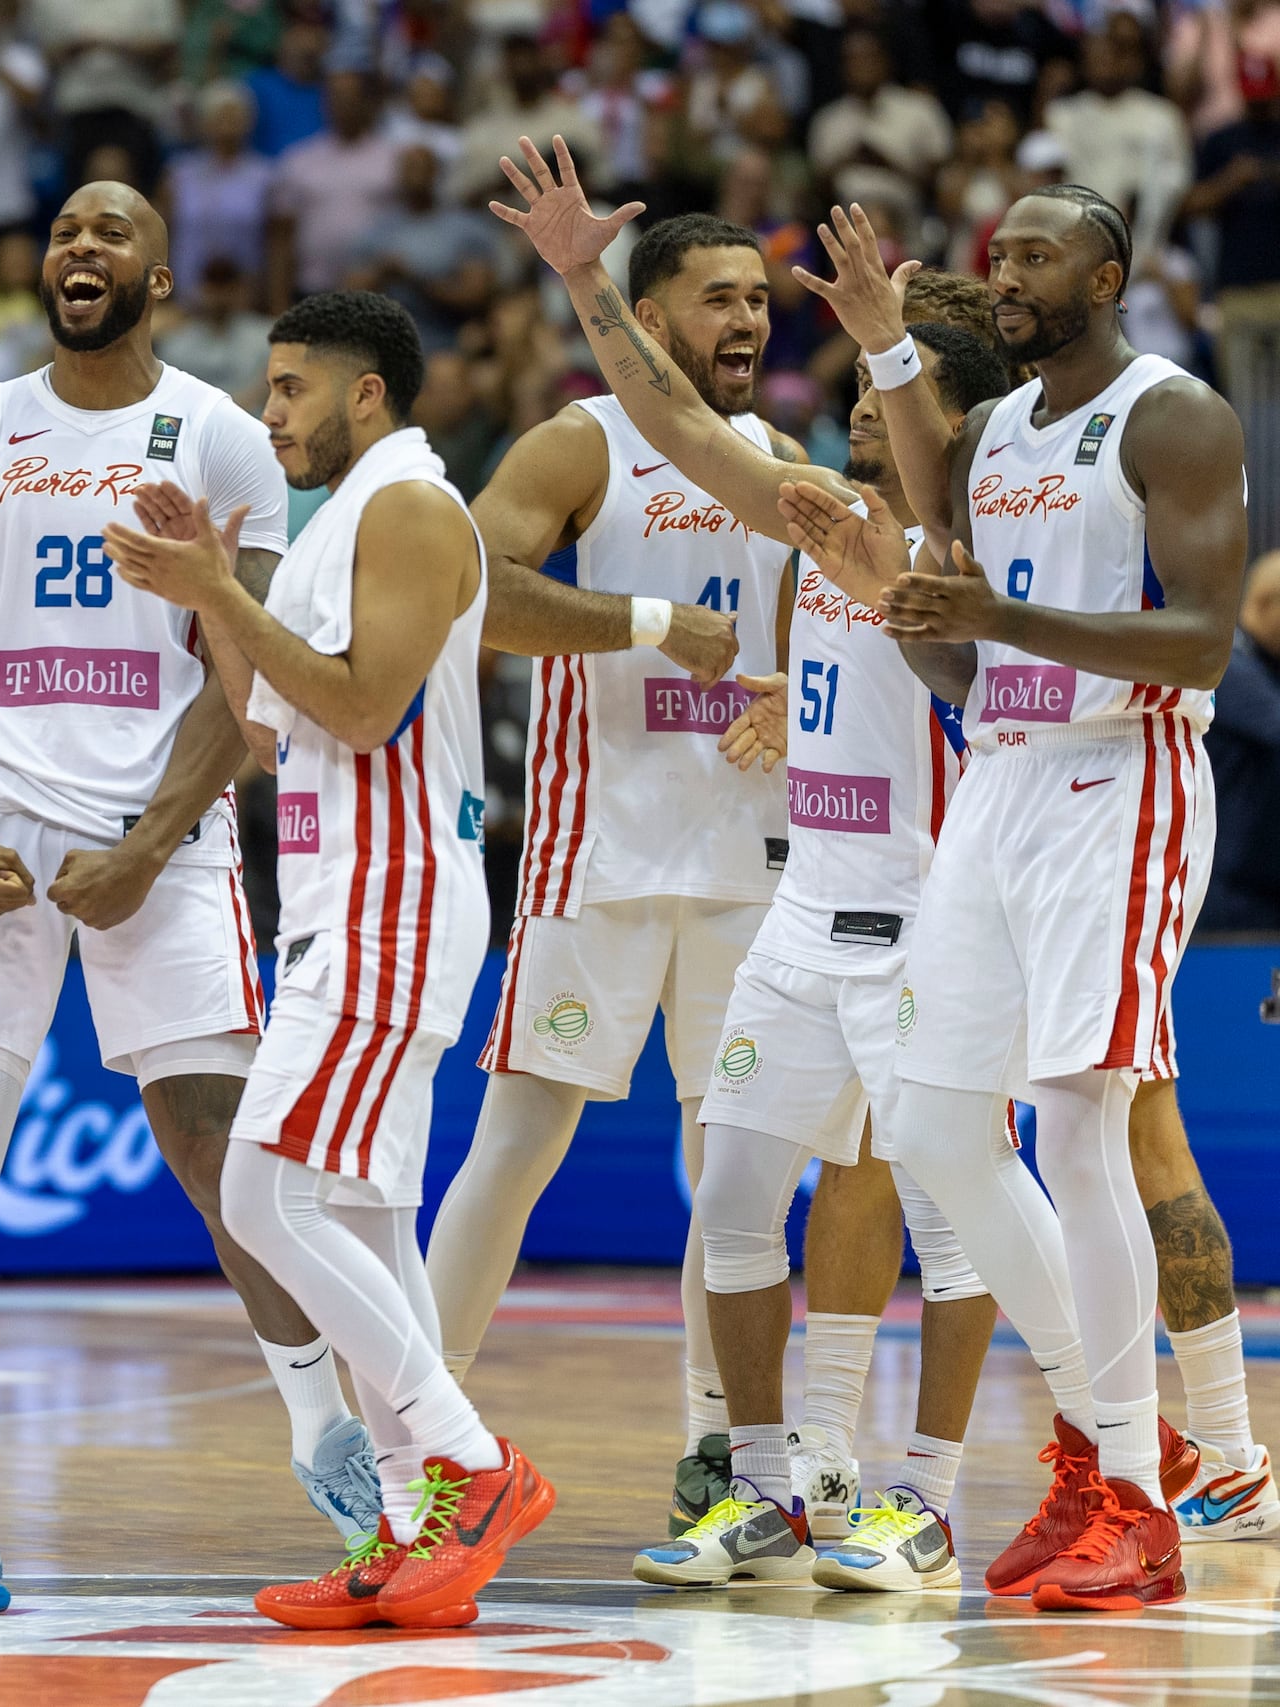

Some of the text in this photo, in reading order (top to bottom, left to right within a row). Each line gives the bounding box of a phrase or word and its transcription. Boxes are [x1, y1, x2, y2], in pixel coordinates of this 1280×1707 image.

[152, 439, 174, 450] FIBA
[1081, 440, 1099, 452] FIBA
[92, 463, 144, 506] Ri
[972, 473, 1082, 523] Puerto Rico
[643, 491, 727, 539] Puerto
[35, 535, 113, 608] 28
[37, 658, 148, 698] Mobile
[685, 689, 750, 724] Mob
[799, 659, 839, 736] 51
[997, 731, 1028, 747] PUR
[793, 780, 878, 823] Mobile
[544, 991, 575, 1013] LOTERÍA
[559, 1036, 586, 1047] PUERTO
[584, 1019, 595, 1037] RICO
[728, 1073, 754, 1086] PUERTO
[753, 1057, 764, 1075] RICO
